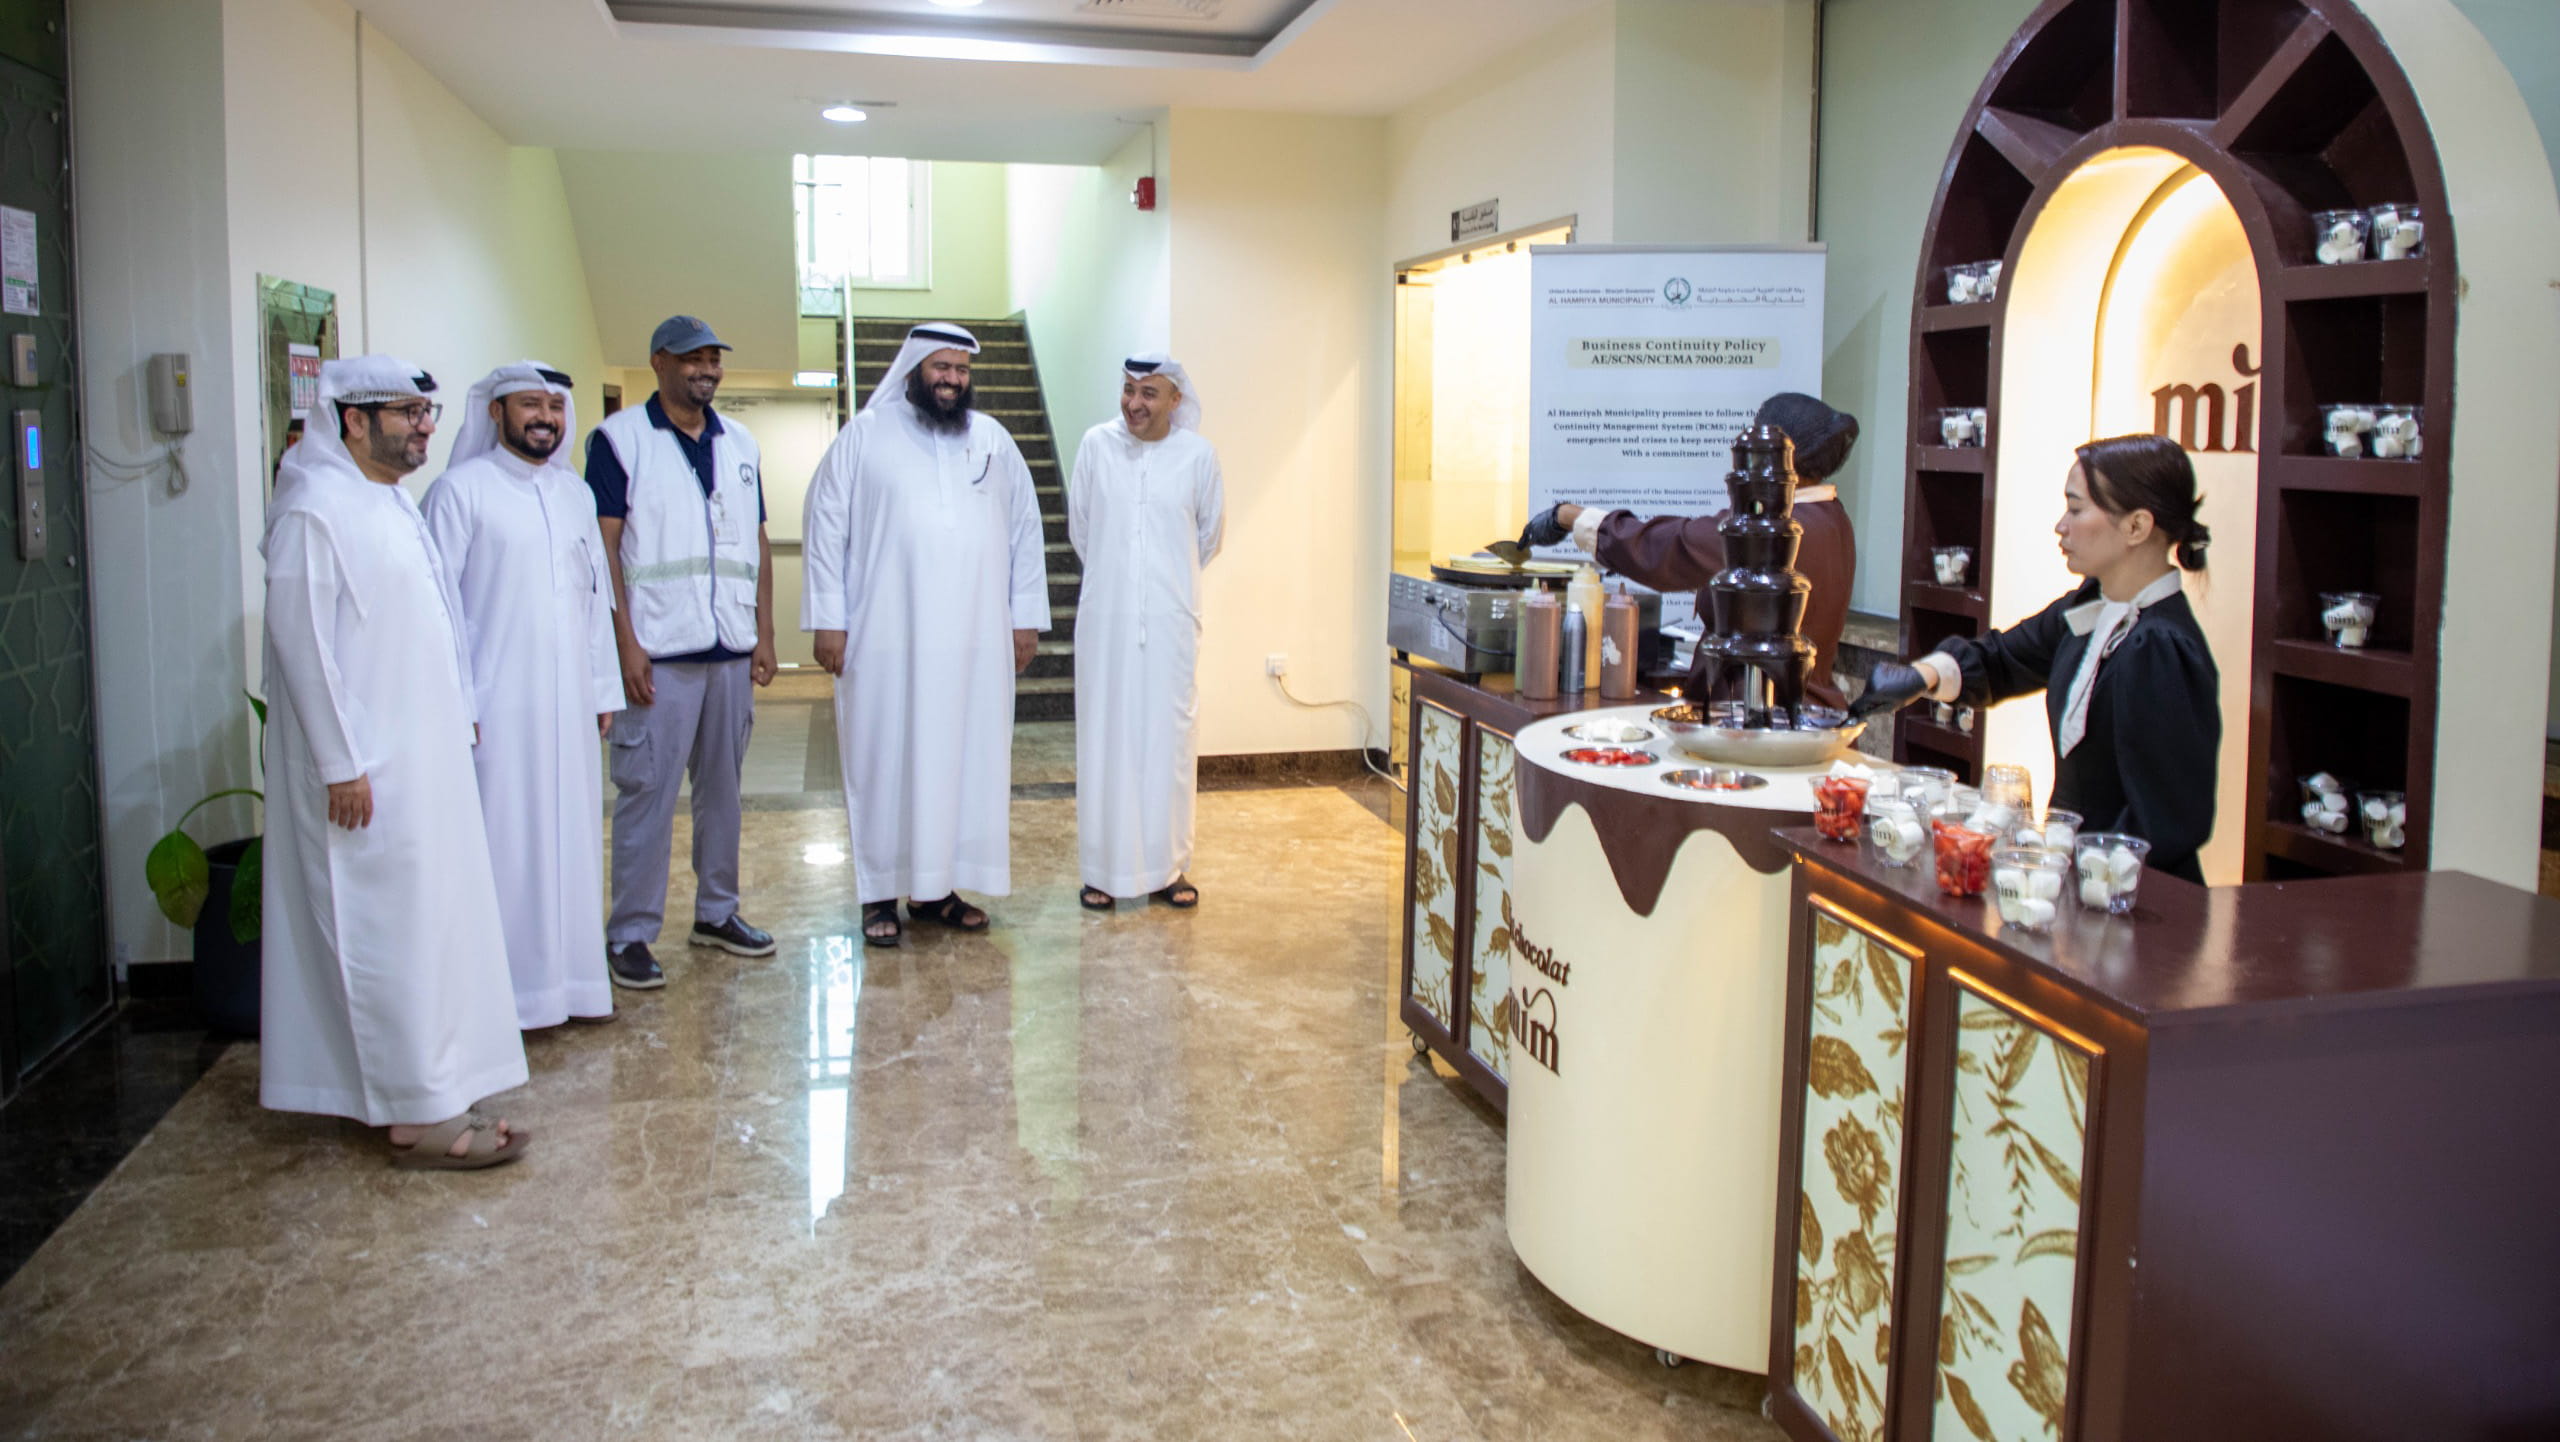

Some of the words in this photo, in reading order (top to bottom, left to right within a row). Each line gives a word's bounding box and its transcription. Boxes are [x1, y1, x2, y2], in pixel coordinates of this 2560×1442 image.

[1582, 340, 1641, 351] Business
[1645, 340, 1720, 353] Continuity
[1724, 340, 1766, 353] Policy
[1591, 354, 1693, 365] AE/SCNS/NCEMA
[1695, 354, 1754, 365] 7000:2021
[2151, 342, 2261, 454] mi
[1547, 409, 1556, 417] Al
[1559, 409, 1602, 419] Hamriyah
[1605, 409, 1660, 419] Municipality
[1663, 409, 1703, 419] promises
[1716, 409, 1744, 417] follow
[1553, 423, 1601, 432] Continuity
[1603, 423, 1659, 432] Management
[1661, 423, 1693, 432] System
[1696, 423, 1727, 432] (BCMS)
[1729, 423, 1746, 431] and
[1566, 436, 1621, 446] emergencies
[1623, 436, 1640, 444] and
[1641, 436, 1668, 444] crises
[1681, 436, 1701, 446] keep
[1622, 449, 1643, 457] With
[1652, 449, 1710, 457] commitment
